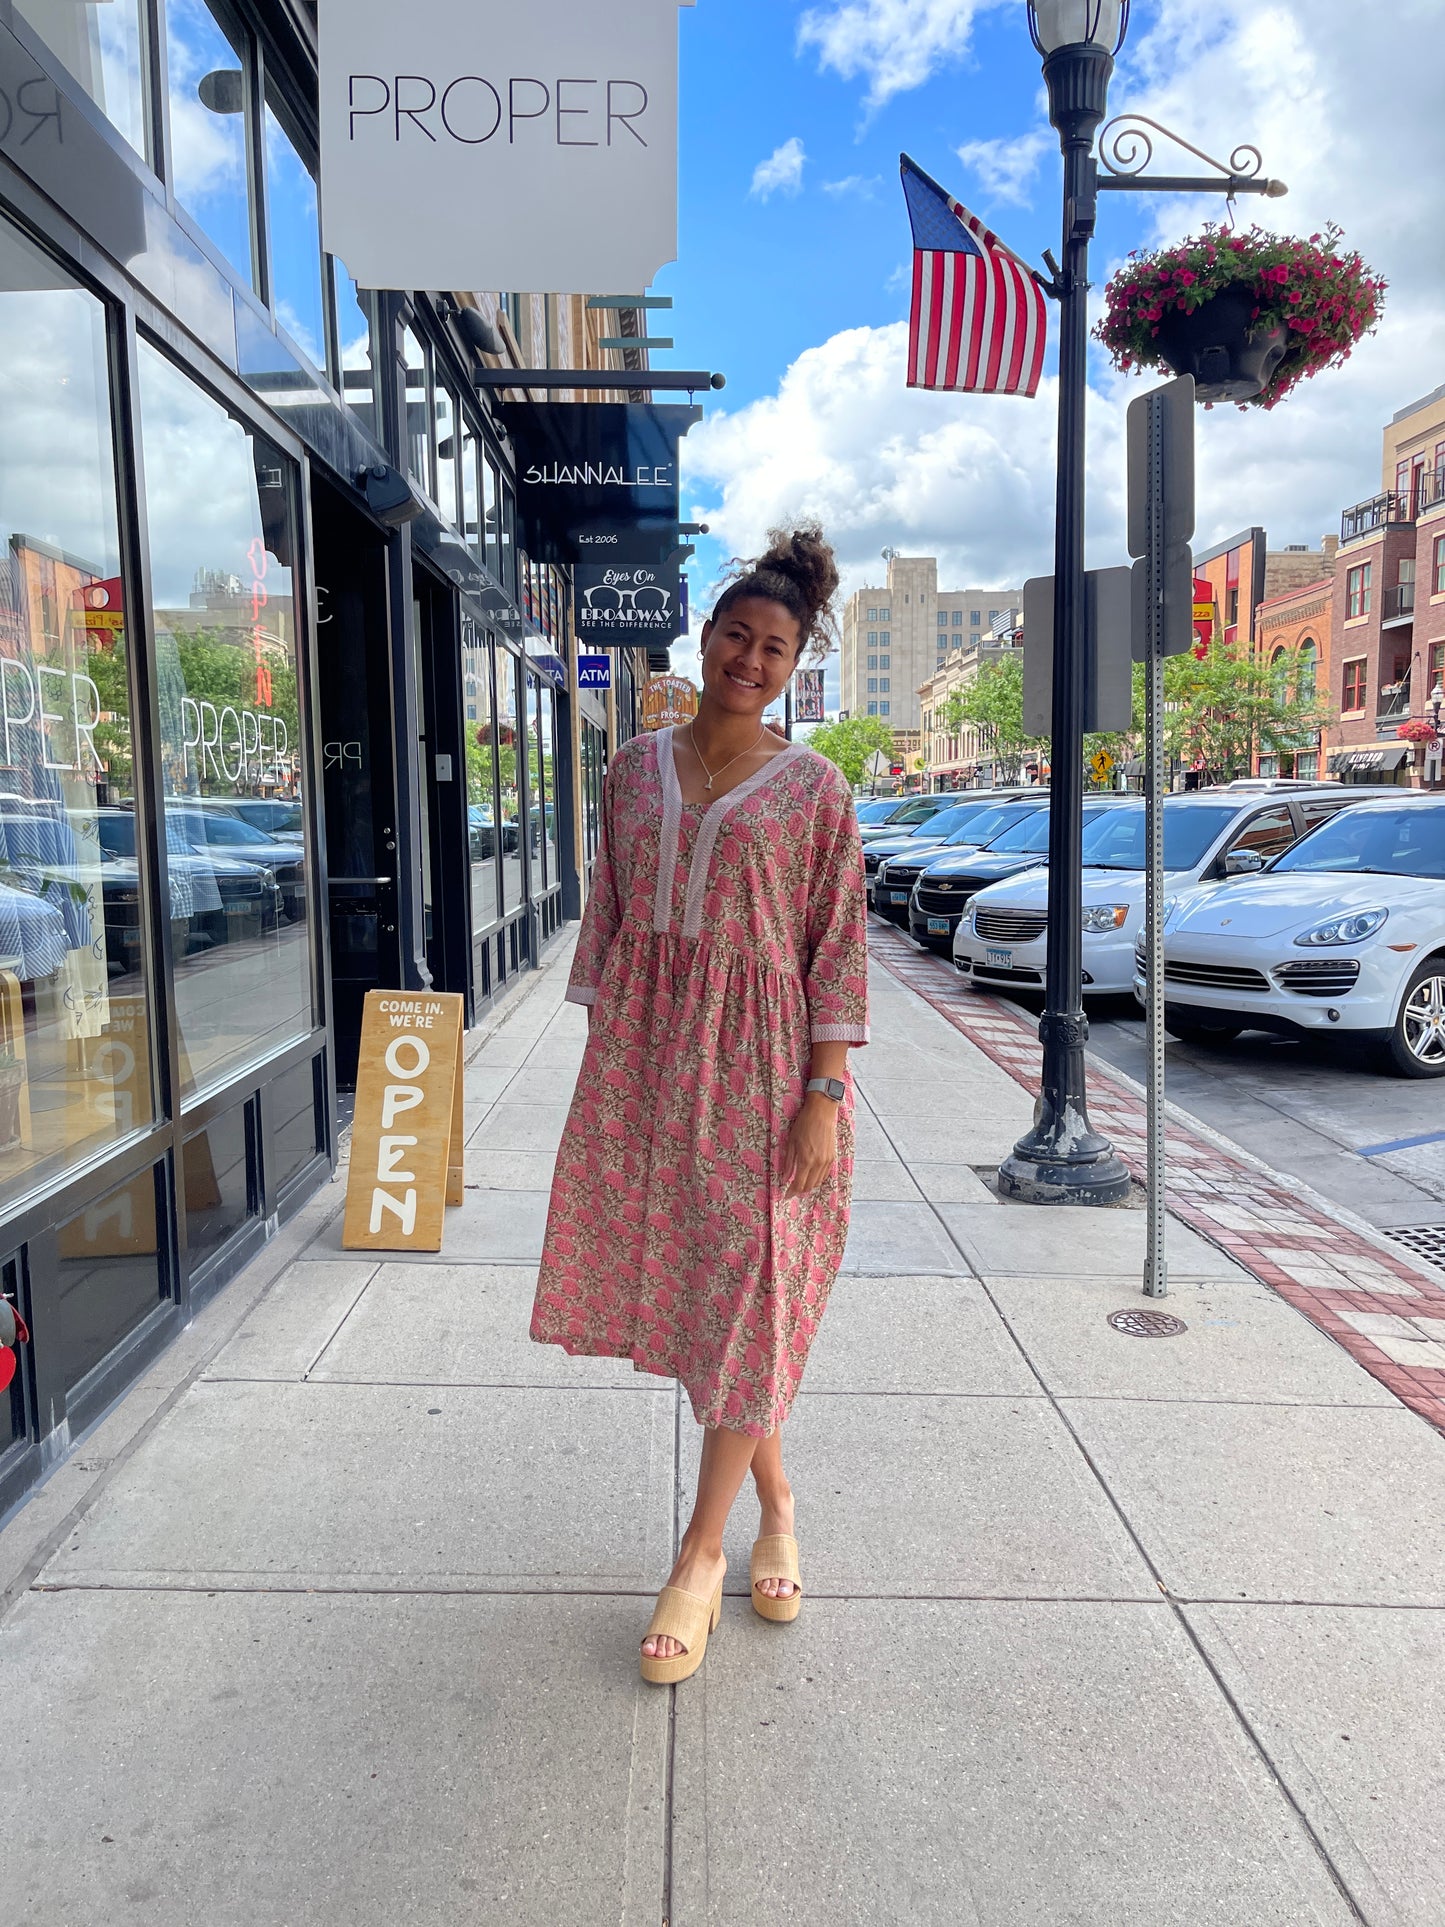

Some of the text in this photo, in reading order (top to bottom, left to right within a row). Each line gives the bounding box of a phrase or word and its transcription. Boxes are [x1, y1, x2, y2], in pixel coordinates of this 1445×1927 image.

[349, 75, 648, 147] PROPER
[523, 461, 672, 486] SHANNALEE
[578, 534, 618, 544] Est 2006
[603, 569, 656, 586] Eyes On
[247, 537, 272, 707] OPEN
[581, 608, 674, 622] BROADWAY
[619, 621, 672, 629] DIFFERENCE
[579, 669, 610, 681] ATM
[650, 679, 691, 693] THE TOASTED
[660, 711, 680, 719] FROG
[181, 697, 290, 784] PROPER
[379, 1000, 445, 1015] COME IN.
[389, 1014, 434, 1029] WE'RE
[369, 1034, 431, 1236] OPEN
